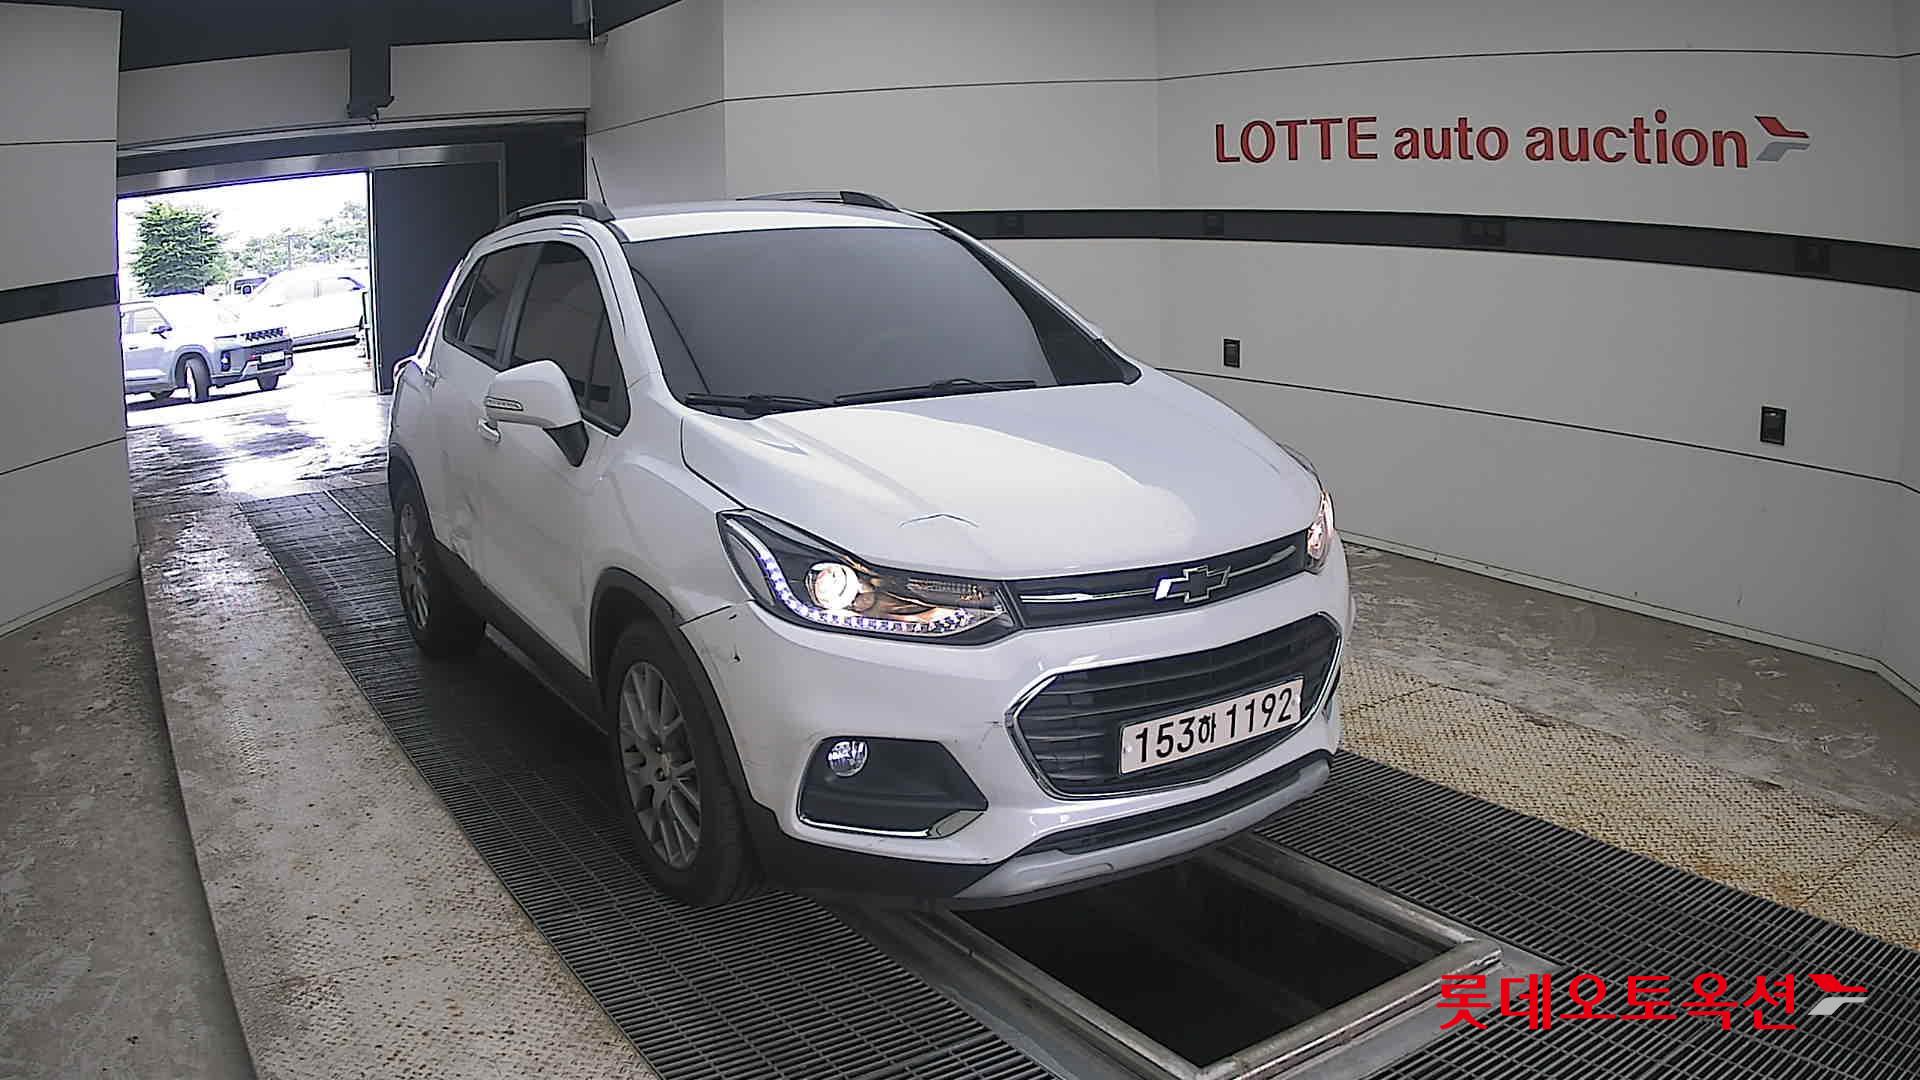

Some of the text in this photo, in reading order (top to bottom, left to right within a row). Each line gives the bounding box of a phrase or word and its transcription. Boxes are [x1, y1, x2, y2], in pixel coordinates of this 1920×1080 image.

[1215, 109, 1748, 168] LOTTE auto auction
[1136, 687, 1293, 763] 153하 1192
